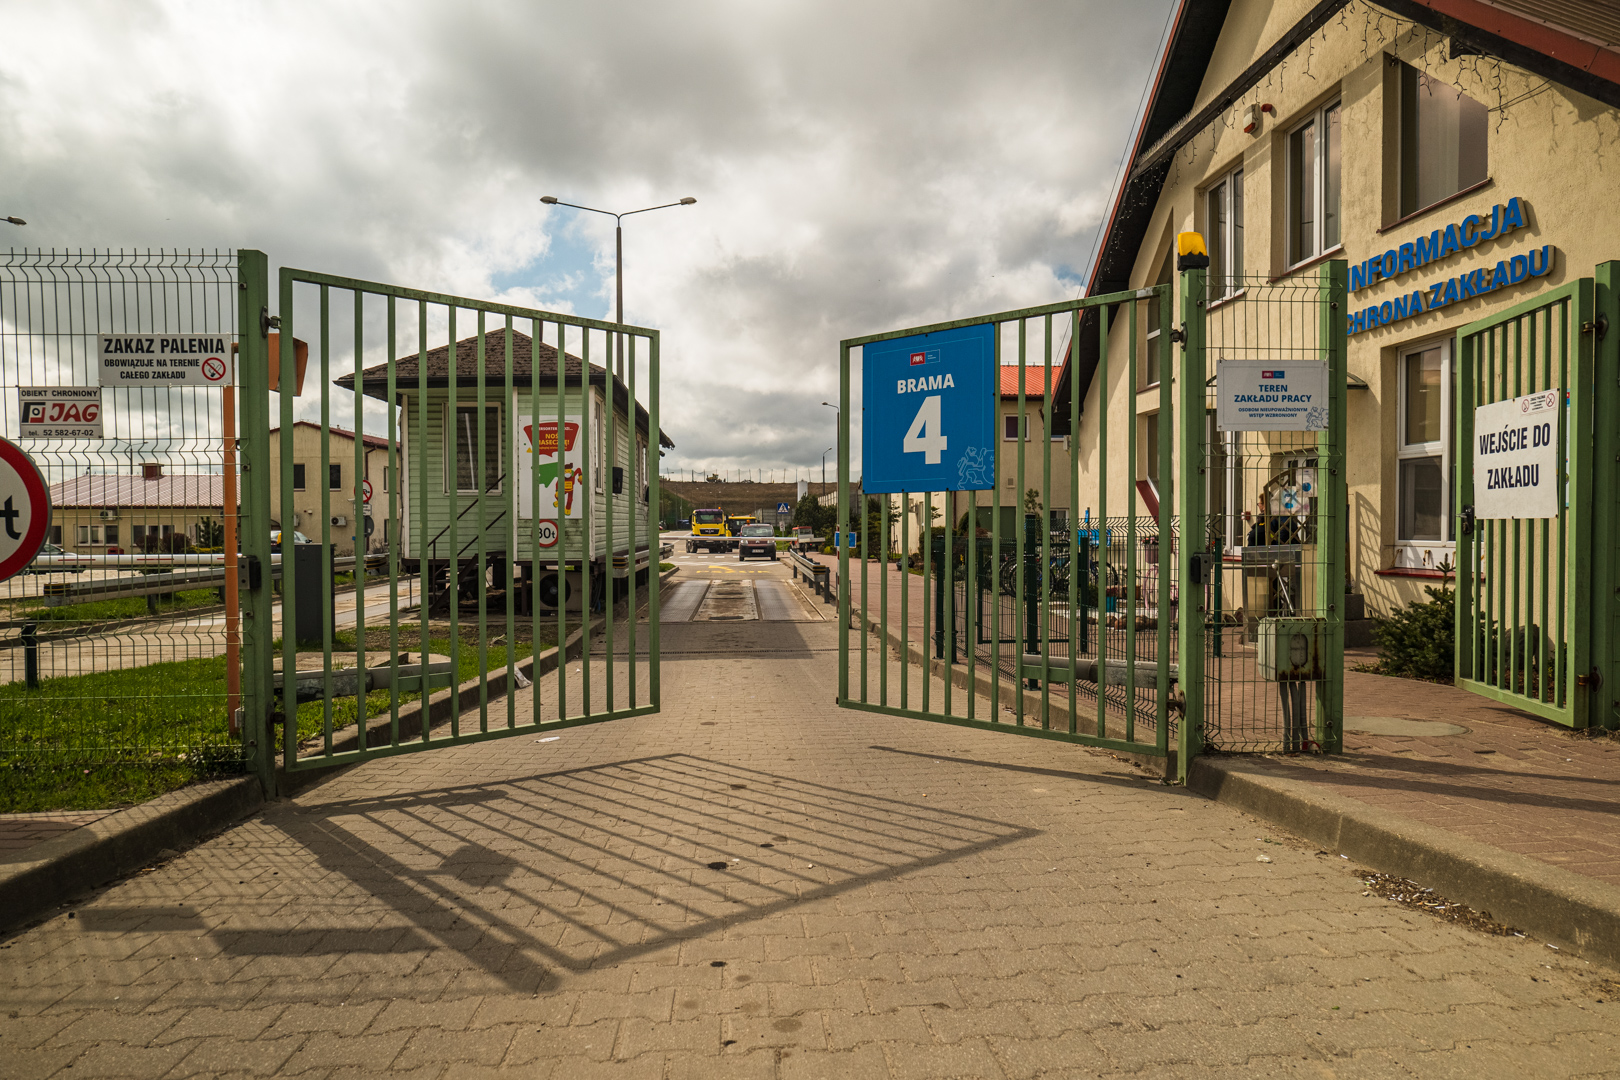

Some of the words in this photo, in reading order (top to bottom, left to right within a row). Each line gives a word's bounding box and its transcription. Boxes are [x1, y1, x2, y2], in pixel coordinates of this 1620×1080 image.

[1348, 197, 1525, 293] INFORMACJA
[1347, 290, 1425, 335] CHRONA
[1429, 245, 1552, 309] ZAKŁADU
[104, 338, 155, 354] ZAKAZ
[160, 338, 225, 354] PALENIA
[104, 359, 154, 369] OBOWIĄZUJE
[156, 359, 167, 367] NA
[169, 359, 200, 367] TERENIE
[120, 371, 149, 379] CAŁEGO
[151, 371, 186, 379] ZAKŁADU
[897, 373, 955, 394] BRAMA
[1234, 394, 1279, 402] ZAKŁADU
[1281, 394, 1312, 402] PRACY
[1258, 384, 1288, 392] TEREN
[49, 403, 99, 422] JAG
[903, 394, 948, 465] 4
[1479, 424, 1528, 455] WEJŚCIE
[1532, 422, 1551, 448] DO
[1487, 463, 1539, 490] ZAKŁADU
